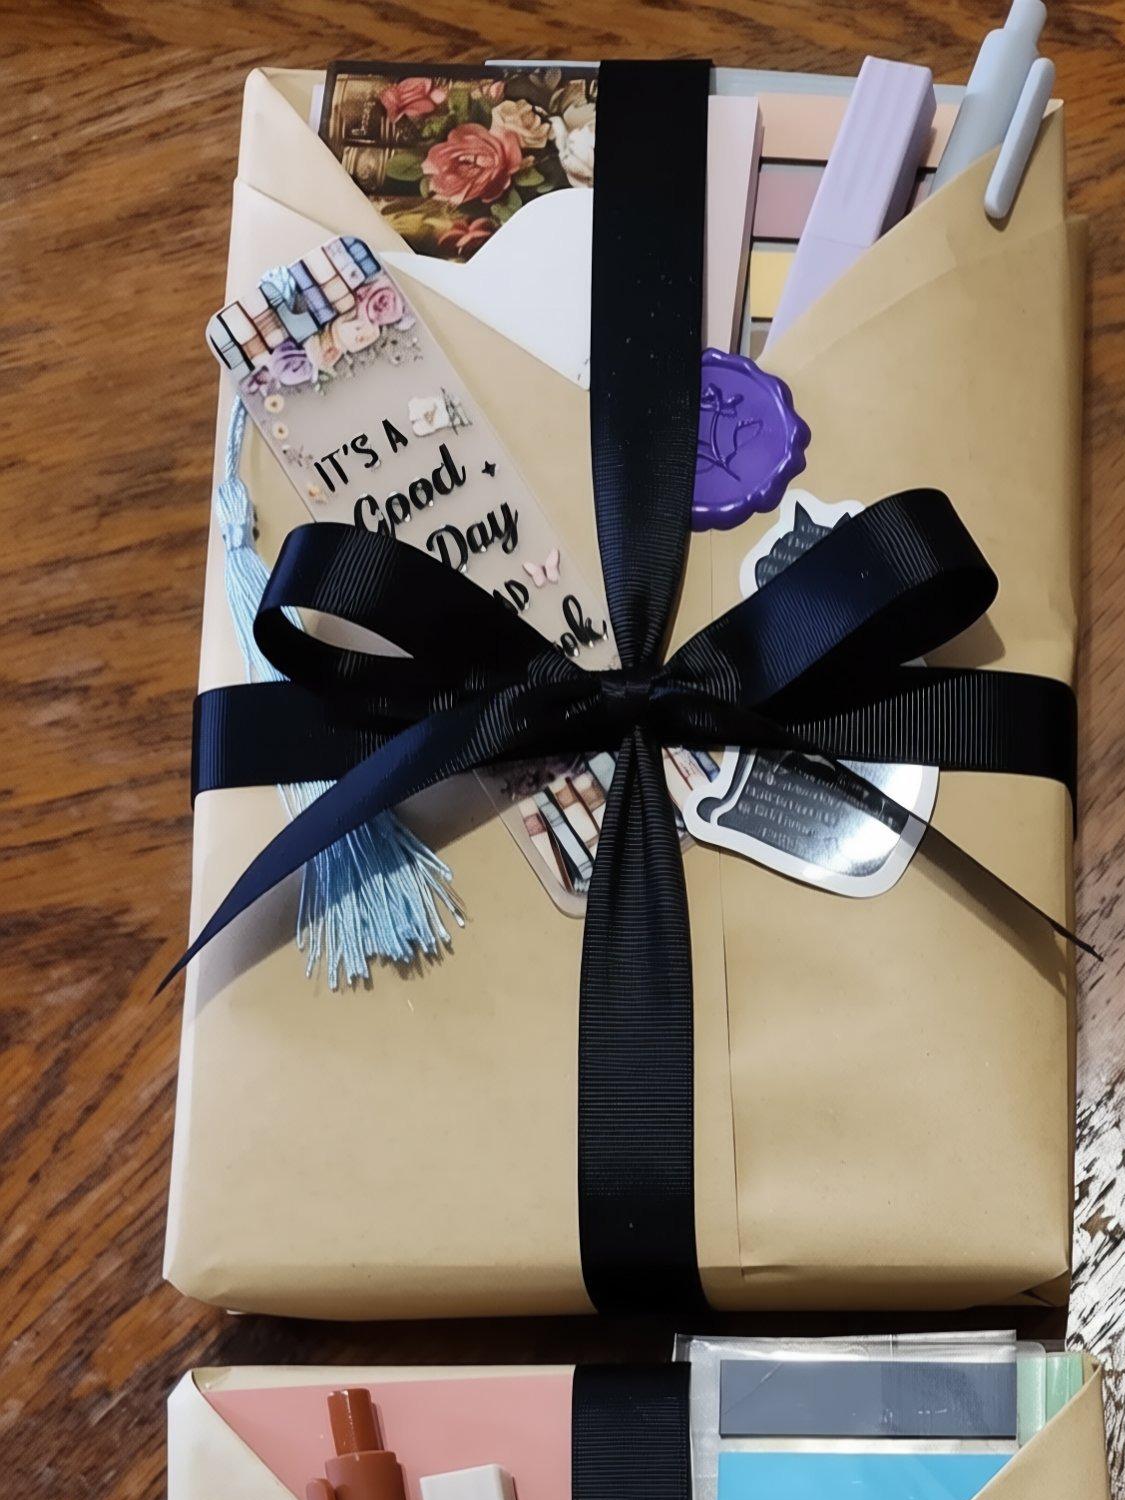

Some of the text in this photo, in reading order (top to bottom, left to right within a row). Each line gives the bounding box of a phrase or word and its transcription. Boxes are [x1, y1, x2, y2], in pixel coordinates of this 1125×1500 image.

[313, 418, 409, 493] IT'S A
[352, 443, 468, 538] Good
[425, 500, 521, 573] Day
